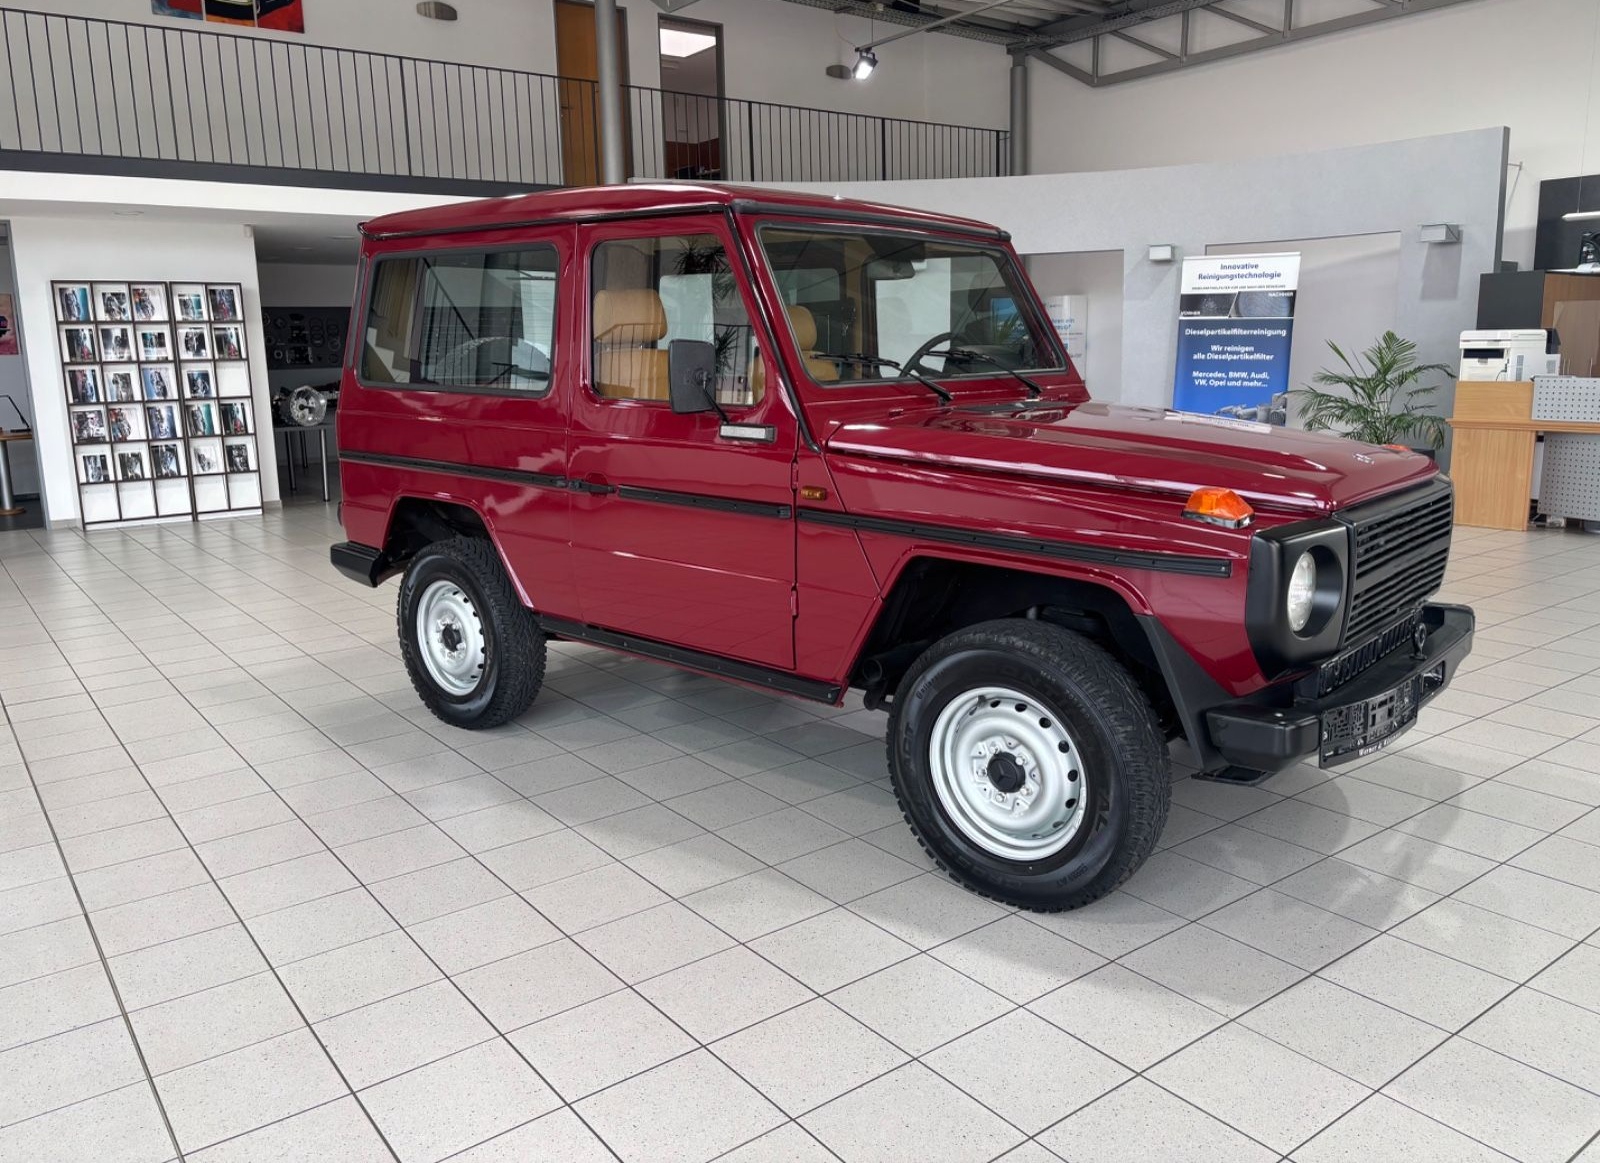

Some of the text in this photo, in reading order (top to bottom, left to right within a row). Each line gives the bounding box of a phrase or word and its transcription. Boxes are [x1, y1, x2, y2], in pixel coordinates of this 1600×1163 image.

[1220, 262, 1259, 271] Innovative
[1198, 271, 1282, 281] Reinigungstechnologie
[1184, 327, 1287, 337] Dieselpartikelfilterreinigung
[1210, 344, 1255, 353] Wir reinigen
[1192, 352, 1275, 361] alle Dieselpartikelfilter
[1192, 370, 1270, 380] Mercedes, BMW, Audi,
[1209, 379, 1226, 388] Opel
[1227, 379, 1242, 387] und
[1242, 379, 1268, 387] mehr...
